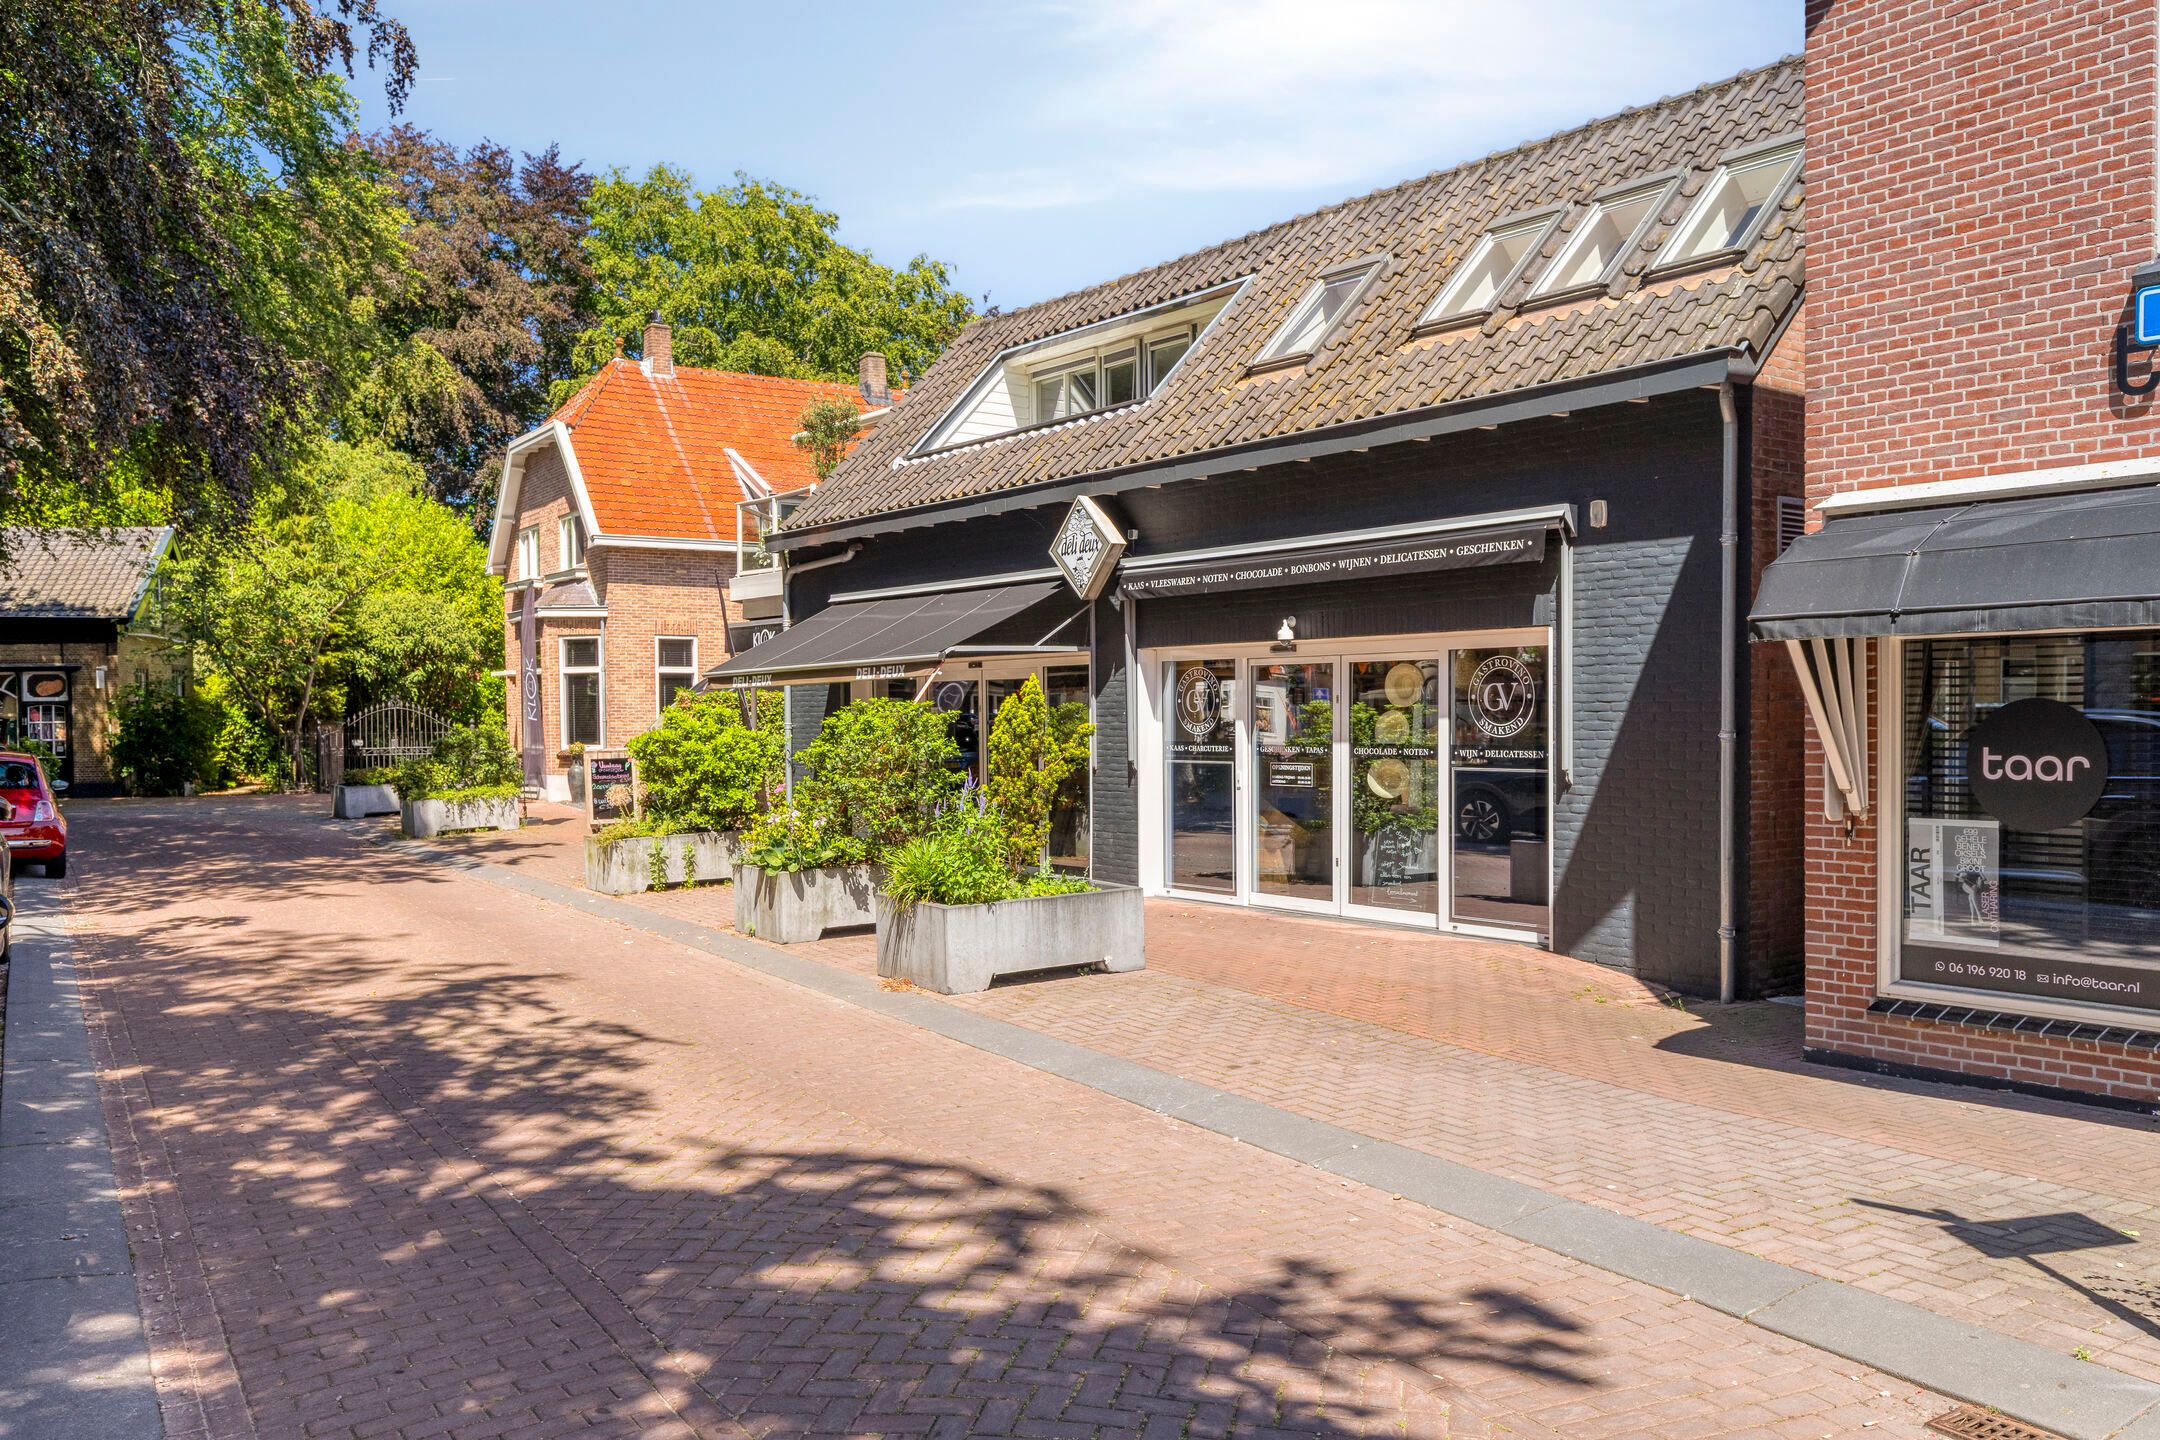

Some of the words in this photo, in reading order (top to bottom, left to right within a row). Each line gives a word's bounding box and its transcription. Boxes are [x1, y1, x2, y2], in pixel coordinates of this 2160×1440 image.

[1079, 531, 1100, 560] deux
[1128, 581, 1144, 591] KAAS
[1150, 576, 1196, 588] VLEESWAREN
[1202, 573, 1229, 584] NOTEN
[1235, 567, 1283, 580] CHOCOLADE
[1290, 561, 1331, 575] BONBONS
[1338, 557, 1372, 570] WIJNEN
[1380, 548, 1447, 565] DELICATESSEN
[1456, 539, 1525, 556] GESCHENKEN
[1179, 669, 1218, 692] GASTROVINO
[1472, 658, 1530, 686] GASTROVINO
[1483, 682, 1519, 711] GV
[1183, 718, 1214, 732] SMAKEND
[1479, 717, 1524, 735] SMAKEND
[1188, 744, 1229, 752] CHARCUTERIE
[1353, 747, 1398, 756] CHOCOLADE
[1403, 748, 1429, 756] NOTEN
[1459, 749, 1479, 758] WIJN
[1485, 750, 1544, 759] DELICATESSEN
[1982, 746, 2091, 781] taar
[1955, 835, 1987, 844] GEHELE
[1911, 847, 1931, 913] TAAR
[1956, 864, 1985, 872] GROOT
[1981, 892, 1991, 919] LASER
[1989, 880, 1999, 933] ONTHARING
[1949, 962, 1963, 974] 06
[1966, 964, 1986, 976] 196
[1989, 966, 2011, 979] 920
[2014, 969, 2027, 981] 18
[2053, 973, 2140, 993] info@taar.nl
